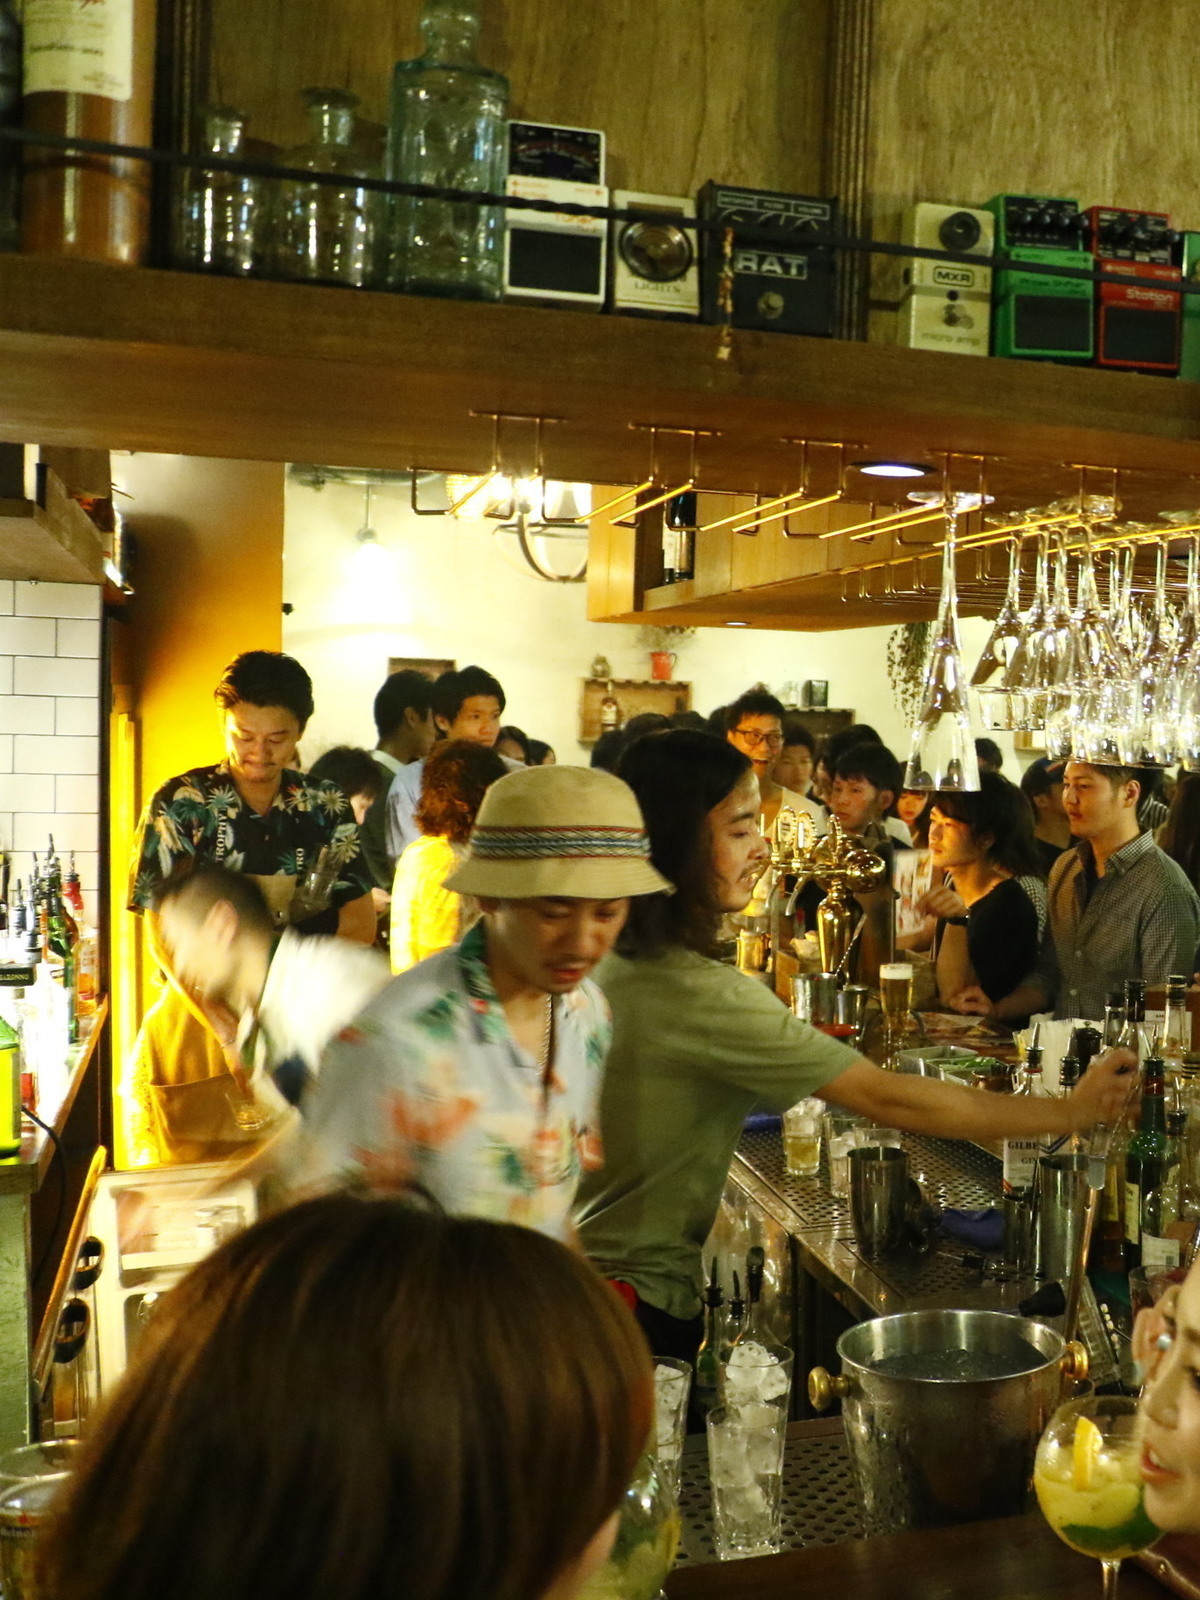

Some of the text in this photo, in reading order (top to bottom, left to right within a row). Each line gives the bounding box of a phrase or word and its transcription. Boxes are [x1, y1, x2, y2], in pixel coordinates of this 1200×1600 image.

[737, 253, 804, 275] RAT
[937, 271, 971, 284] MXR
[1125, 288, 1174, 302] Station
